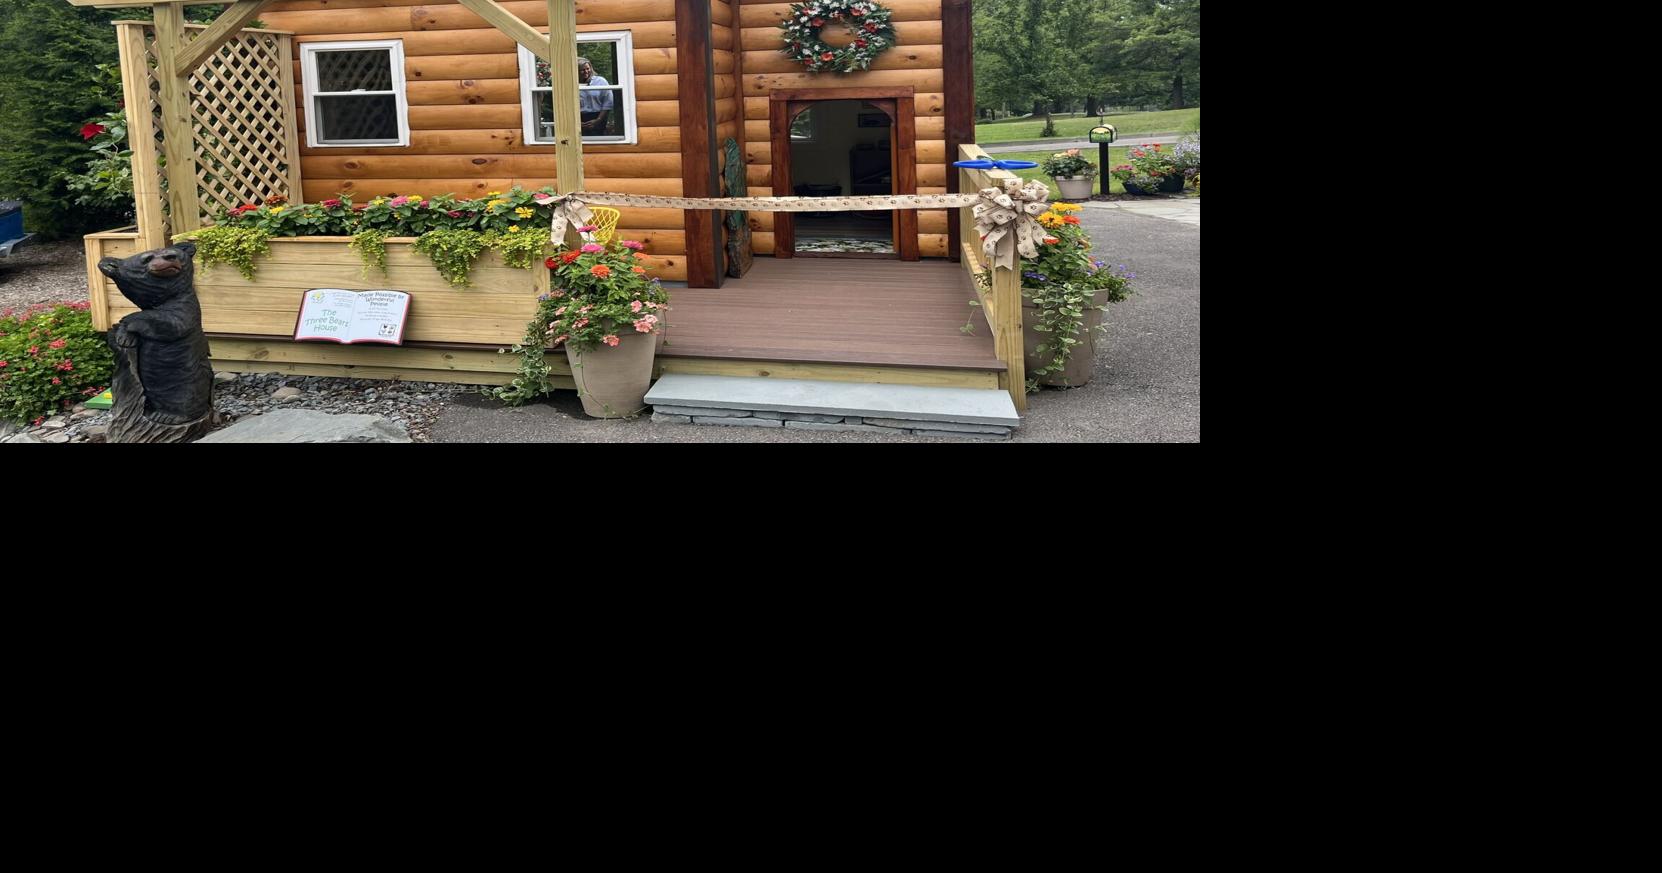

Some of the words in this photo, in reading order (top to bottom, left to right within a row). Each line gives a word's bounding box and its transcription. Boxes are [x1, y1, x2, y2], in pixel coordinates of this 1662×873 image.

[305, 317, 328, 326] Three
[329, 316, 349, 327] Bears
[314, 324, 338, 332] House
